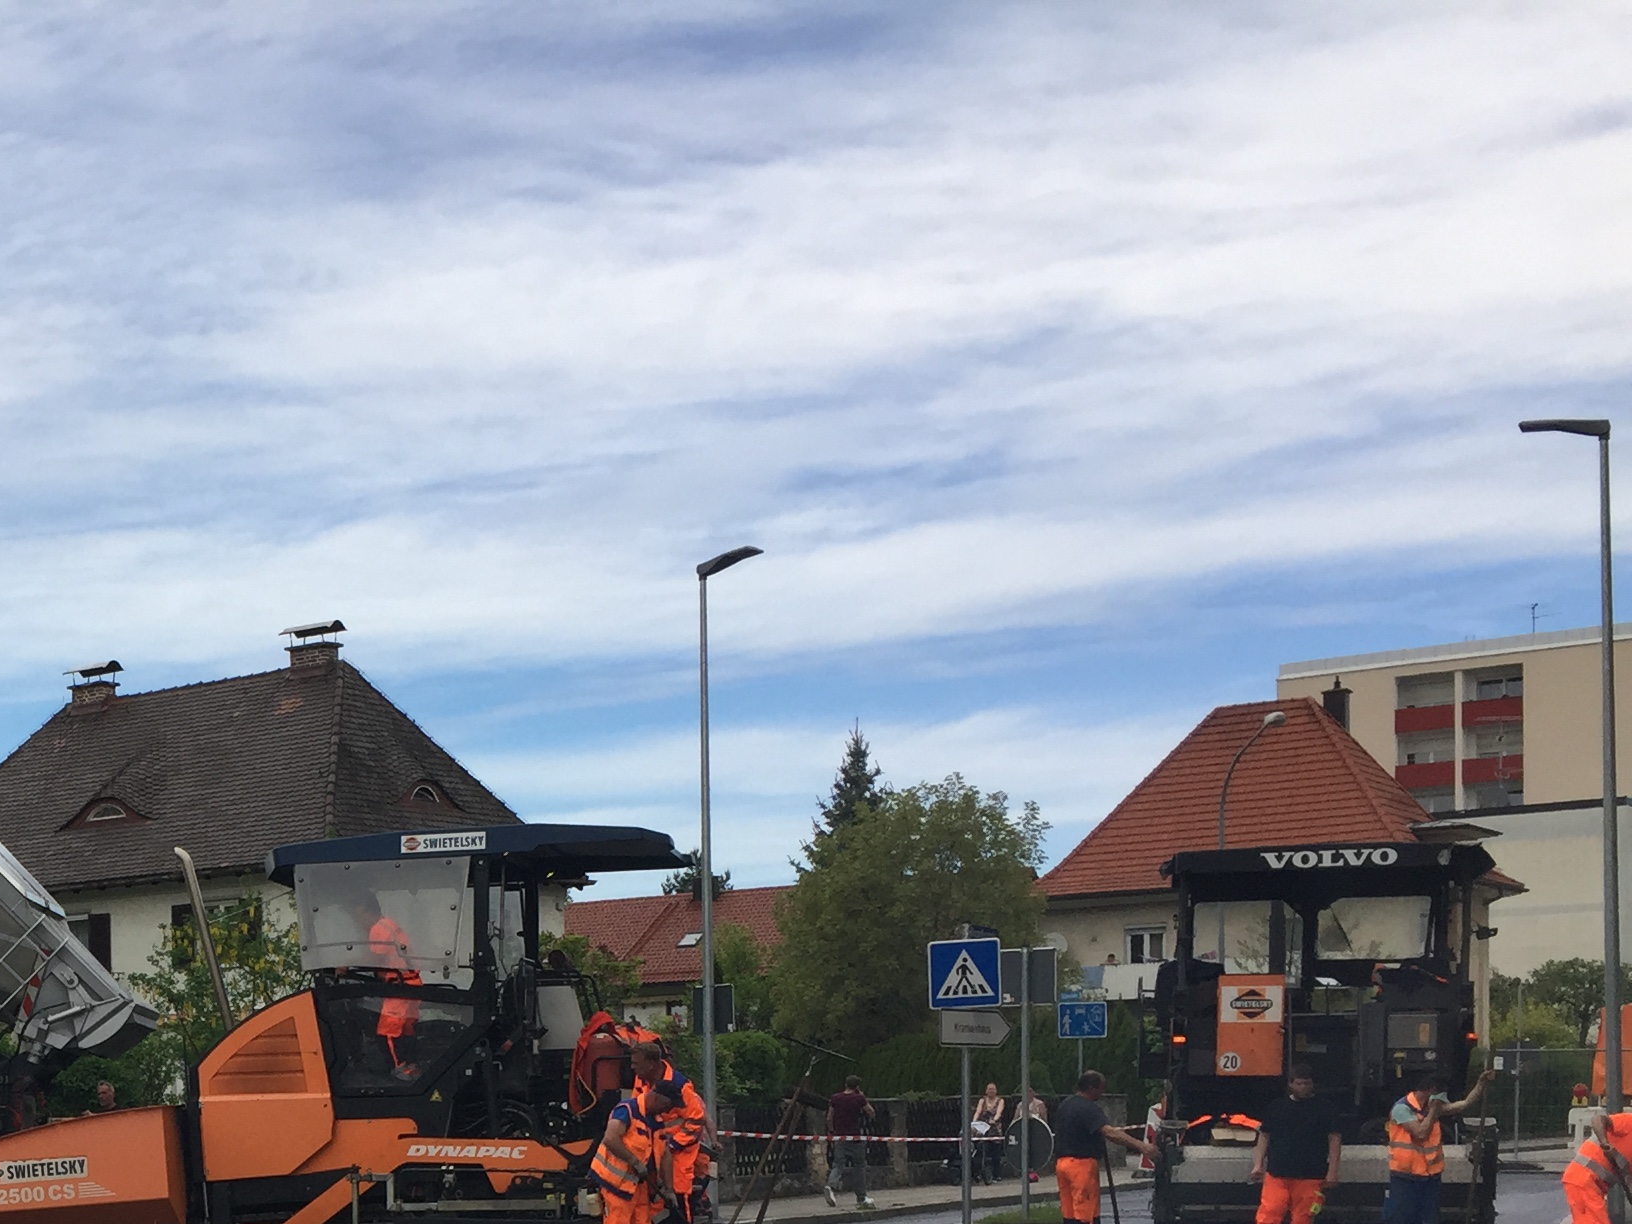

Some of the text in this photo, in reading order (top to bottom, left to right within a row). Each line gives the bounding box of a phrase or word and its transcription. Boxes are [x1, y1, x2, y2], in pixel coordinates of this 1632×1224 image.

[423, 835, 484, 849] SWIETELSKY
[1260, 847, 1398, 869] VOLVO
[1223, 1055, 1238, 1069] 20
[406, 1144, 528, 1159] DYNAPAC
[6, 1158, 86, 1180] SWIETELSKY
[48, 1183, 76, 1200] CS
